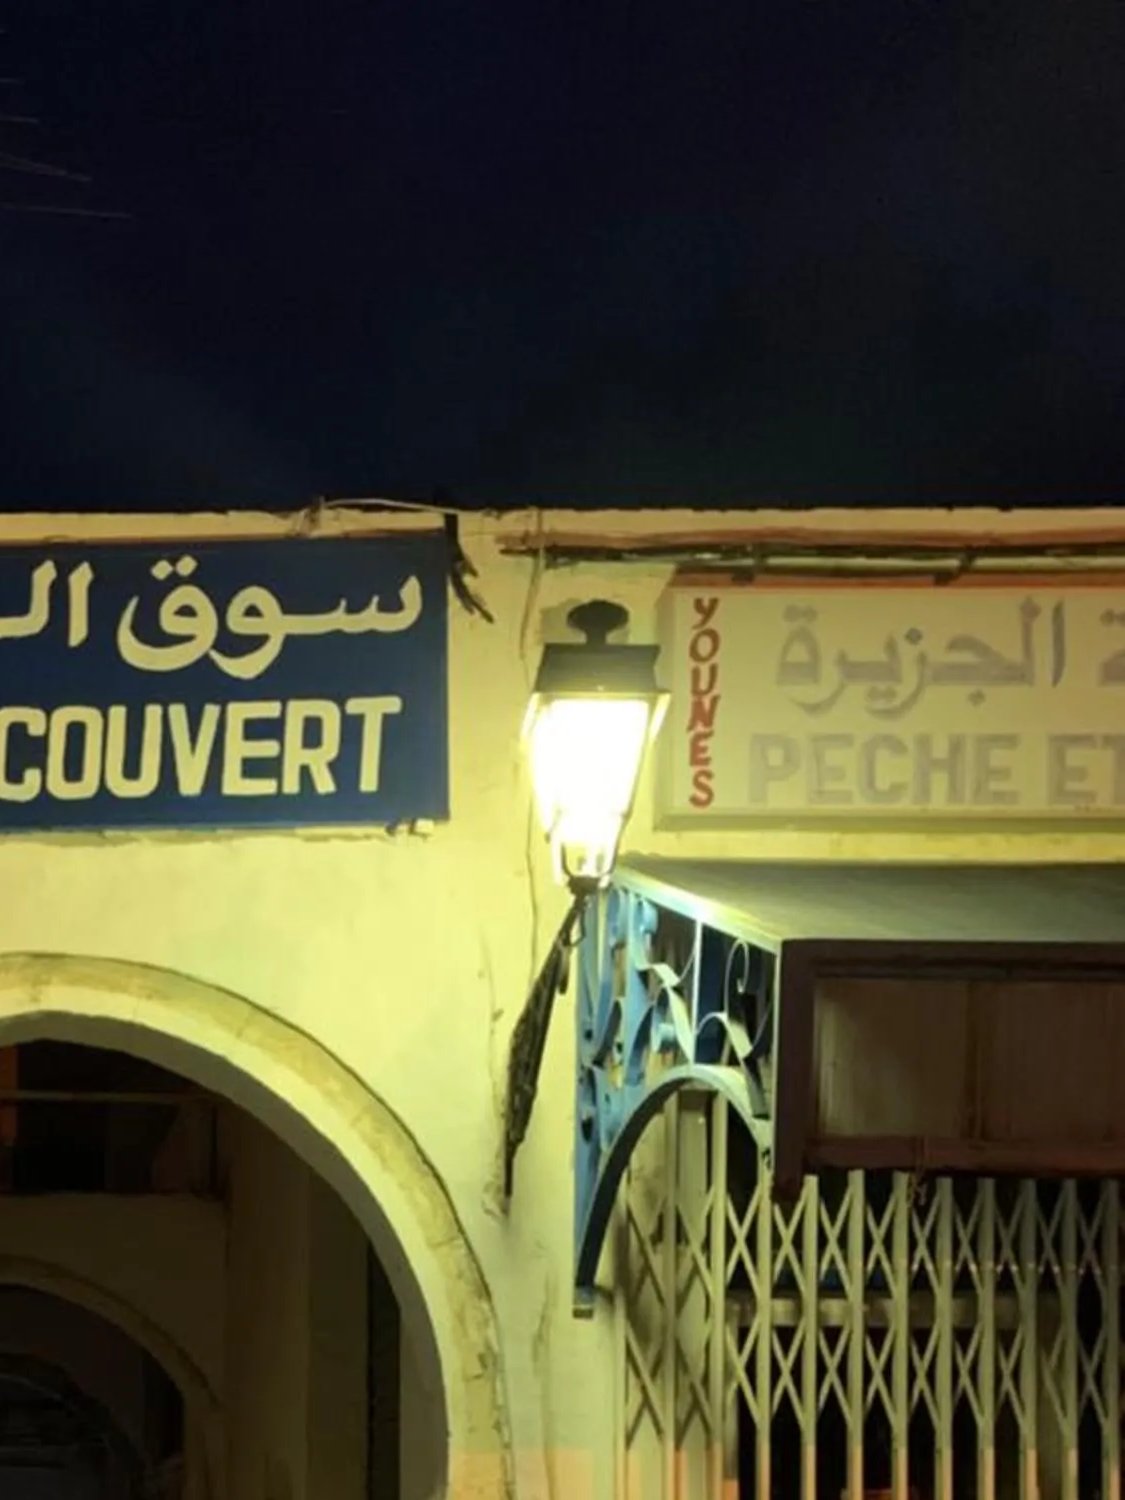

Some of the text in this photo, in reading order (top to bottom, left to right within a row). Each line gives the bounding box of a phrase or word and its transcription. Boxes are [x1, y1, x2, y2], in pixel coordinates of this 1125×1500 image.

[116, 556, 422, 680] سوق
[777, 598, 1067, 720] الجزيرة
[750, 733, 1021, 805] PECHE
